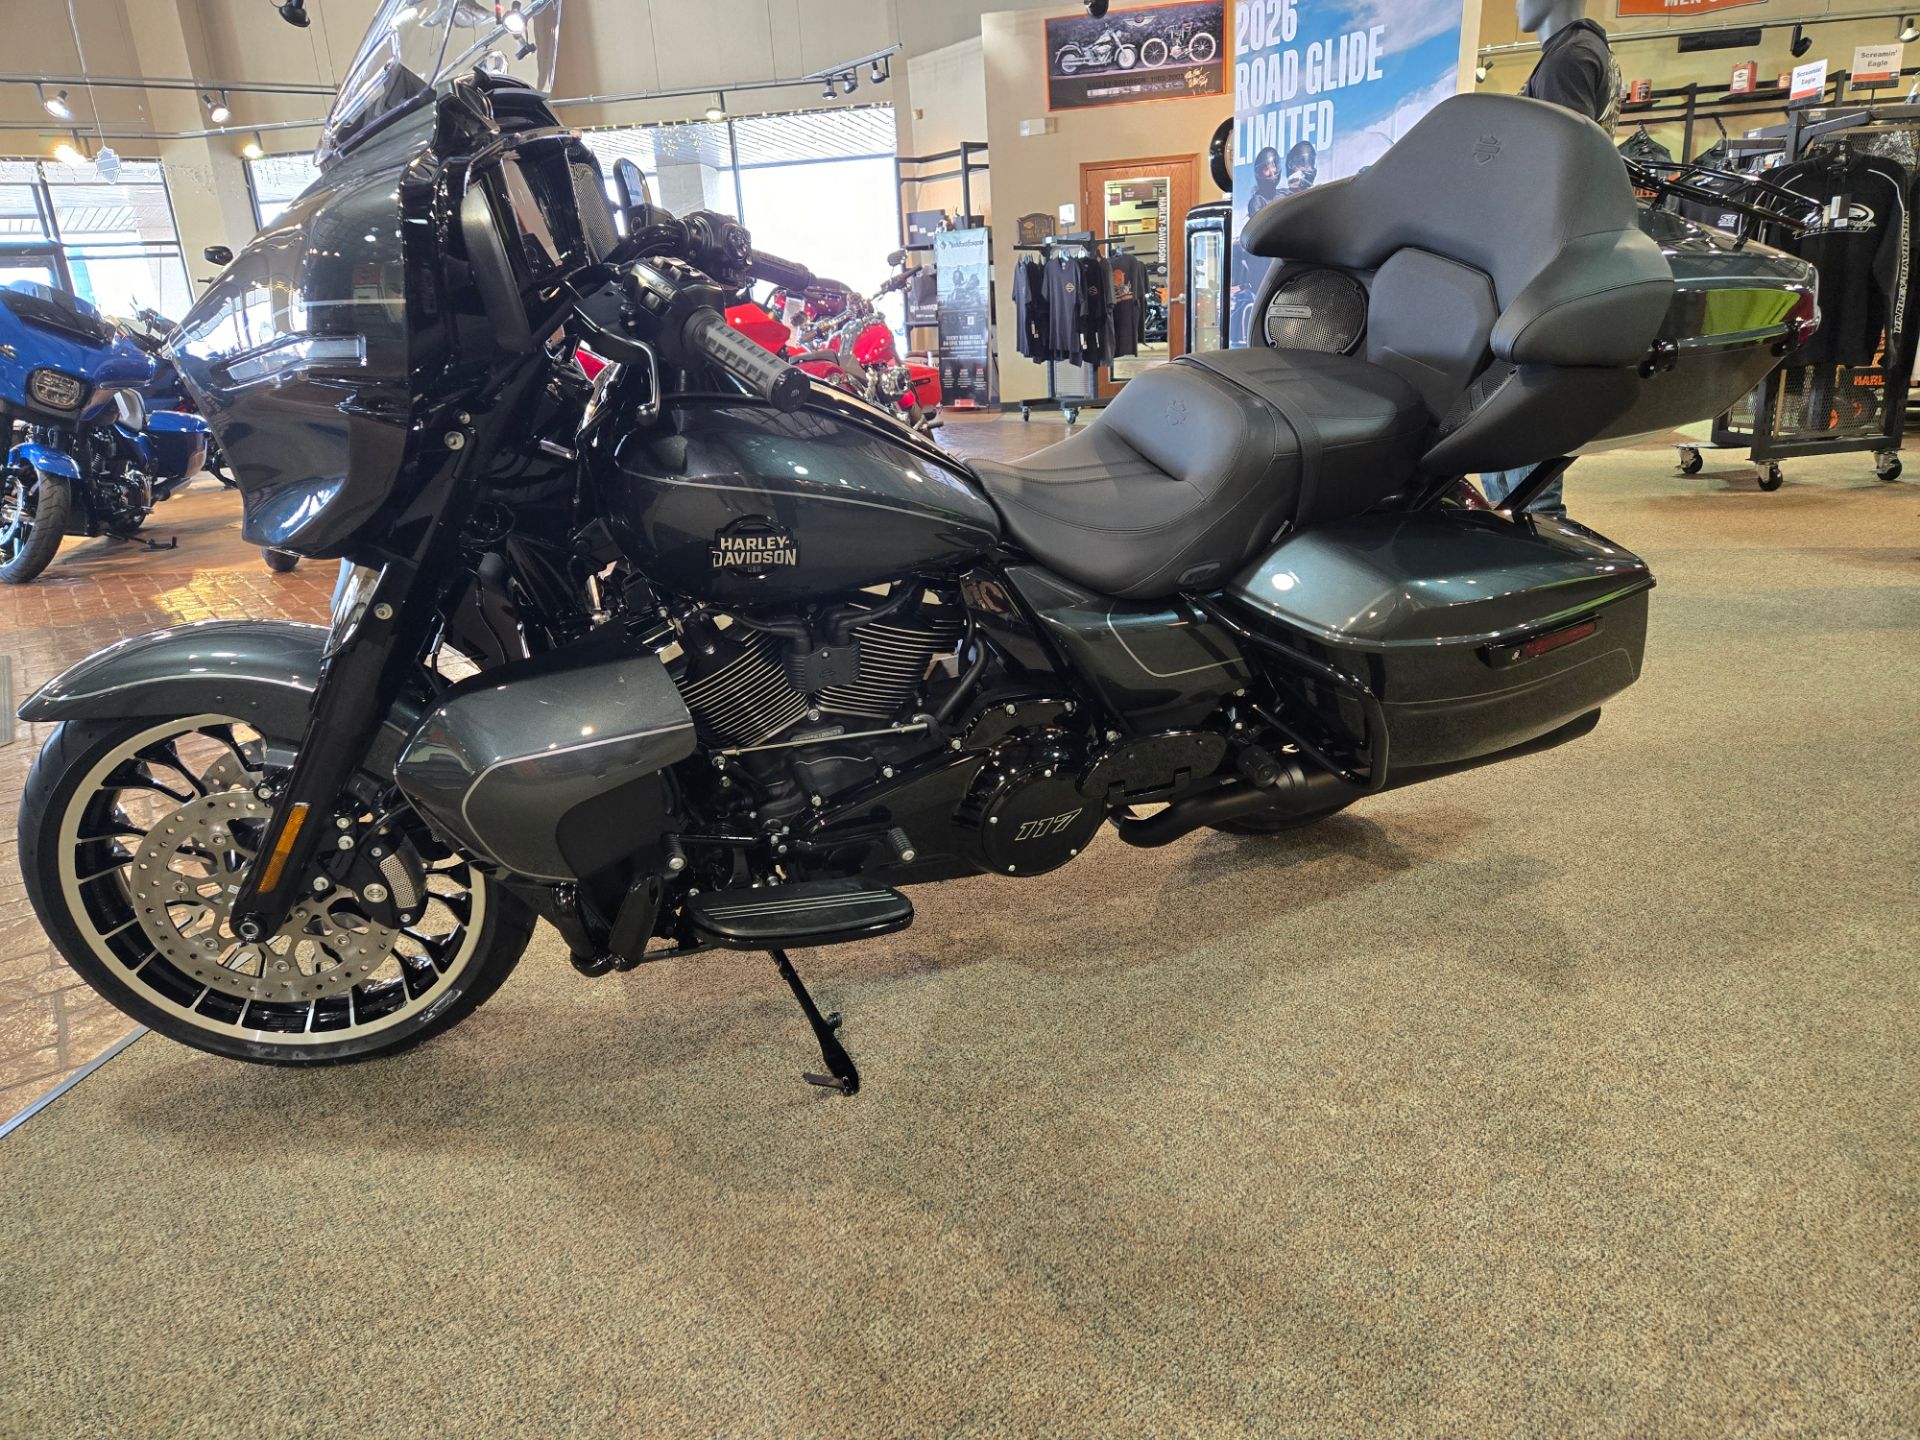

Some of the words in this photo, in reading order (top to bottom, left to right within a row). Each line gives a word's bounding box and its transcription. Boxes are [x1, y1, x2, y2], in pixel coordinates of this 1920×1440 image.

[1235, 0, 1298, 57] 2026
[1860, 49, 1898, 59] Screamin'
[1867, 60, 1888, 68] Eagle
[1235, 49, 1299, 112] ROAD
[1305, 24, 1385, 95] GLIDE
[1796, 65, 1823, 79] Screamin'
[1801, 77, 1816, 85] Eagle
[1233, 99, 1335, 167] LIMITED
[1158, 196, 1168, 264] HARLEY-DAVIDSON
[720, 535, 790, 551] HARLEY-
[711, 548, 797, 568] DAVIDSON
[1014, 807, 1083, 841] 117
